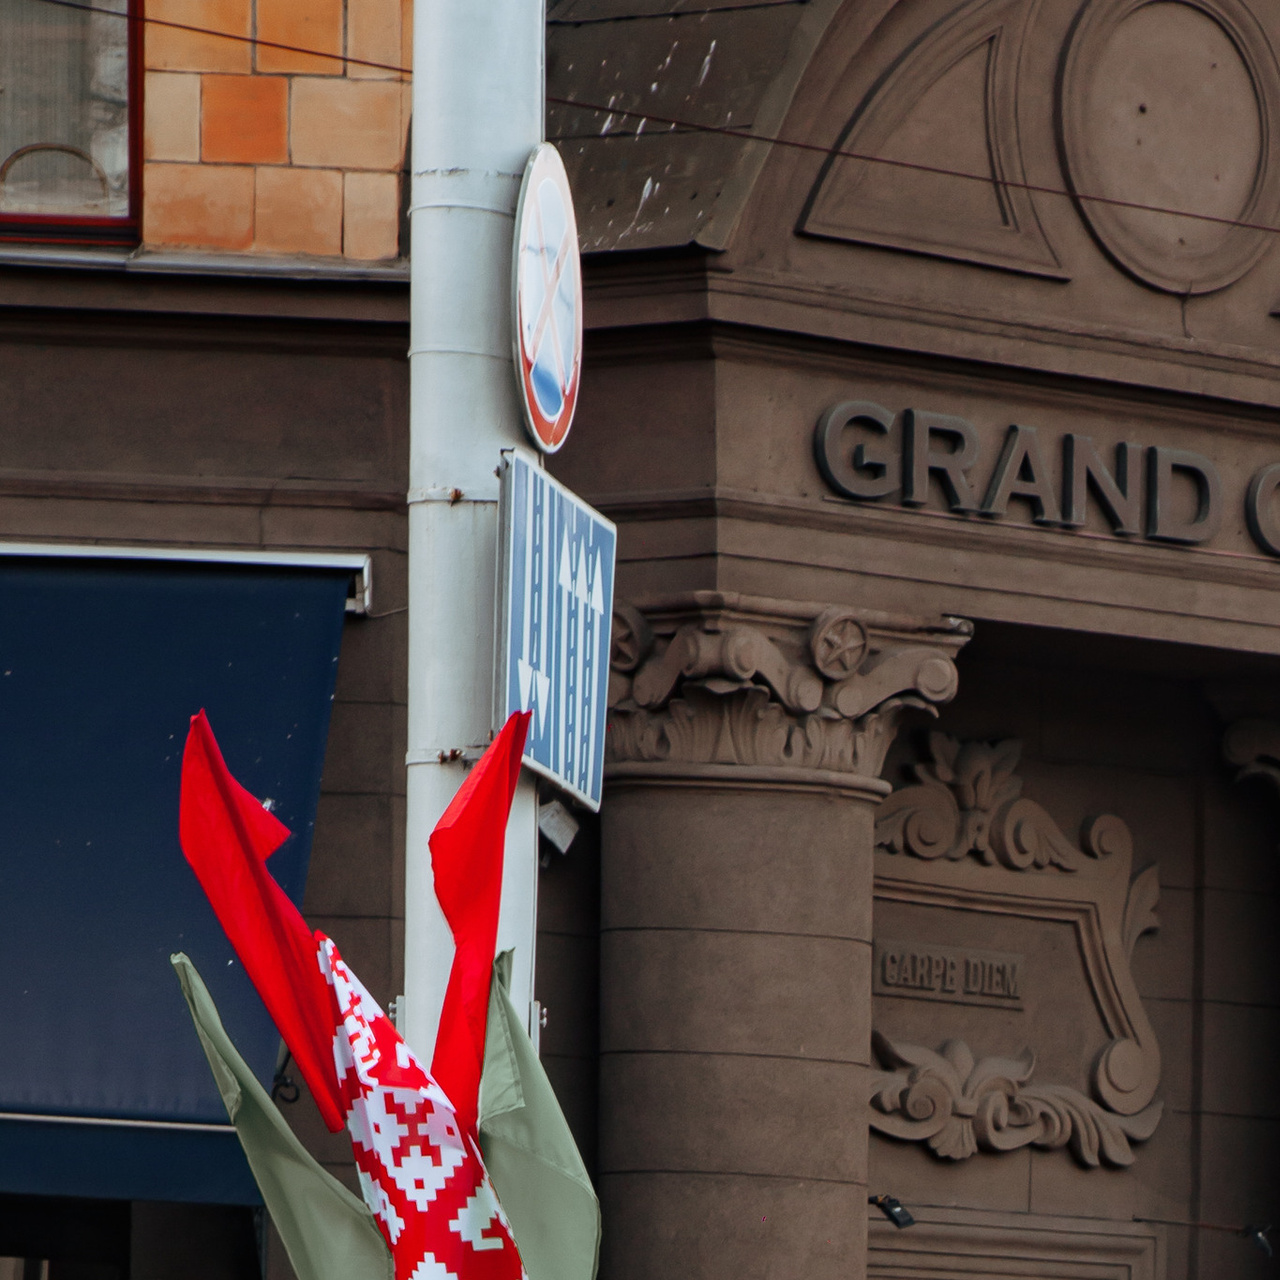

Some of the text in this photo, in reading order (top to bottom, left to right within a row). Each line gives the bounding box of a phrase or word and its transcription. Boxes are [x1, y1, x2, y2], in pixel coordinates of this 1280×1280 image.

[812, 399, 1222, 544] GRAND
[880, 951, 1020, 1000] CARPE DIEM
